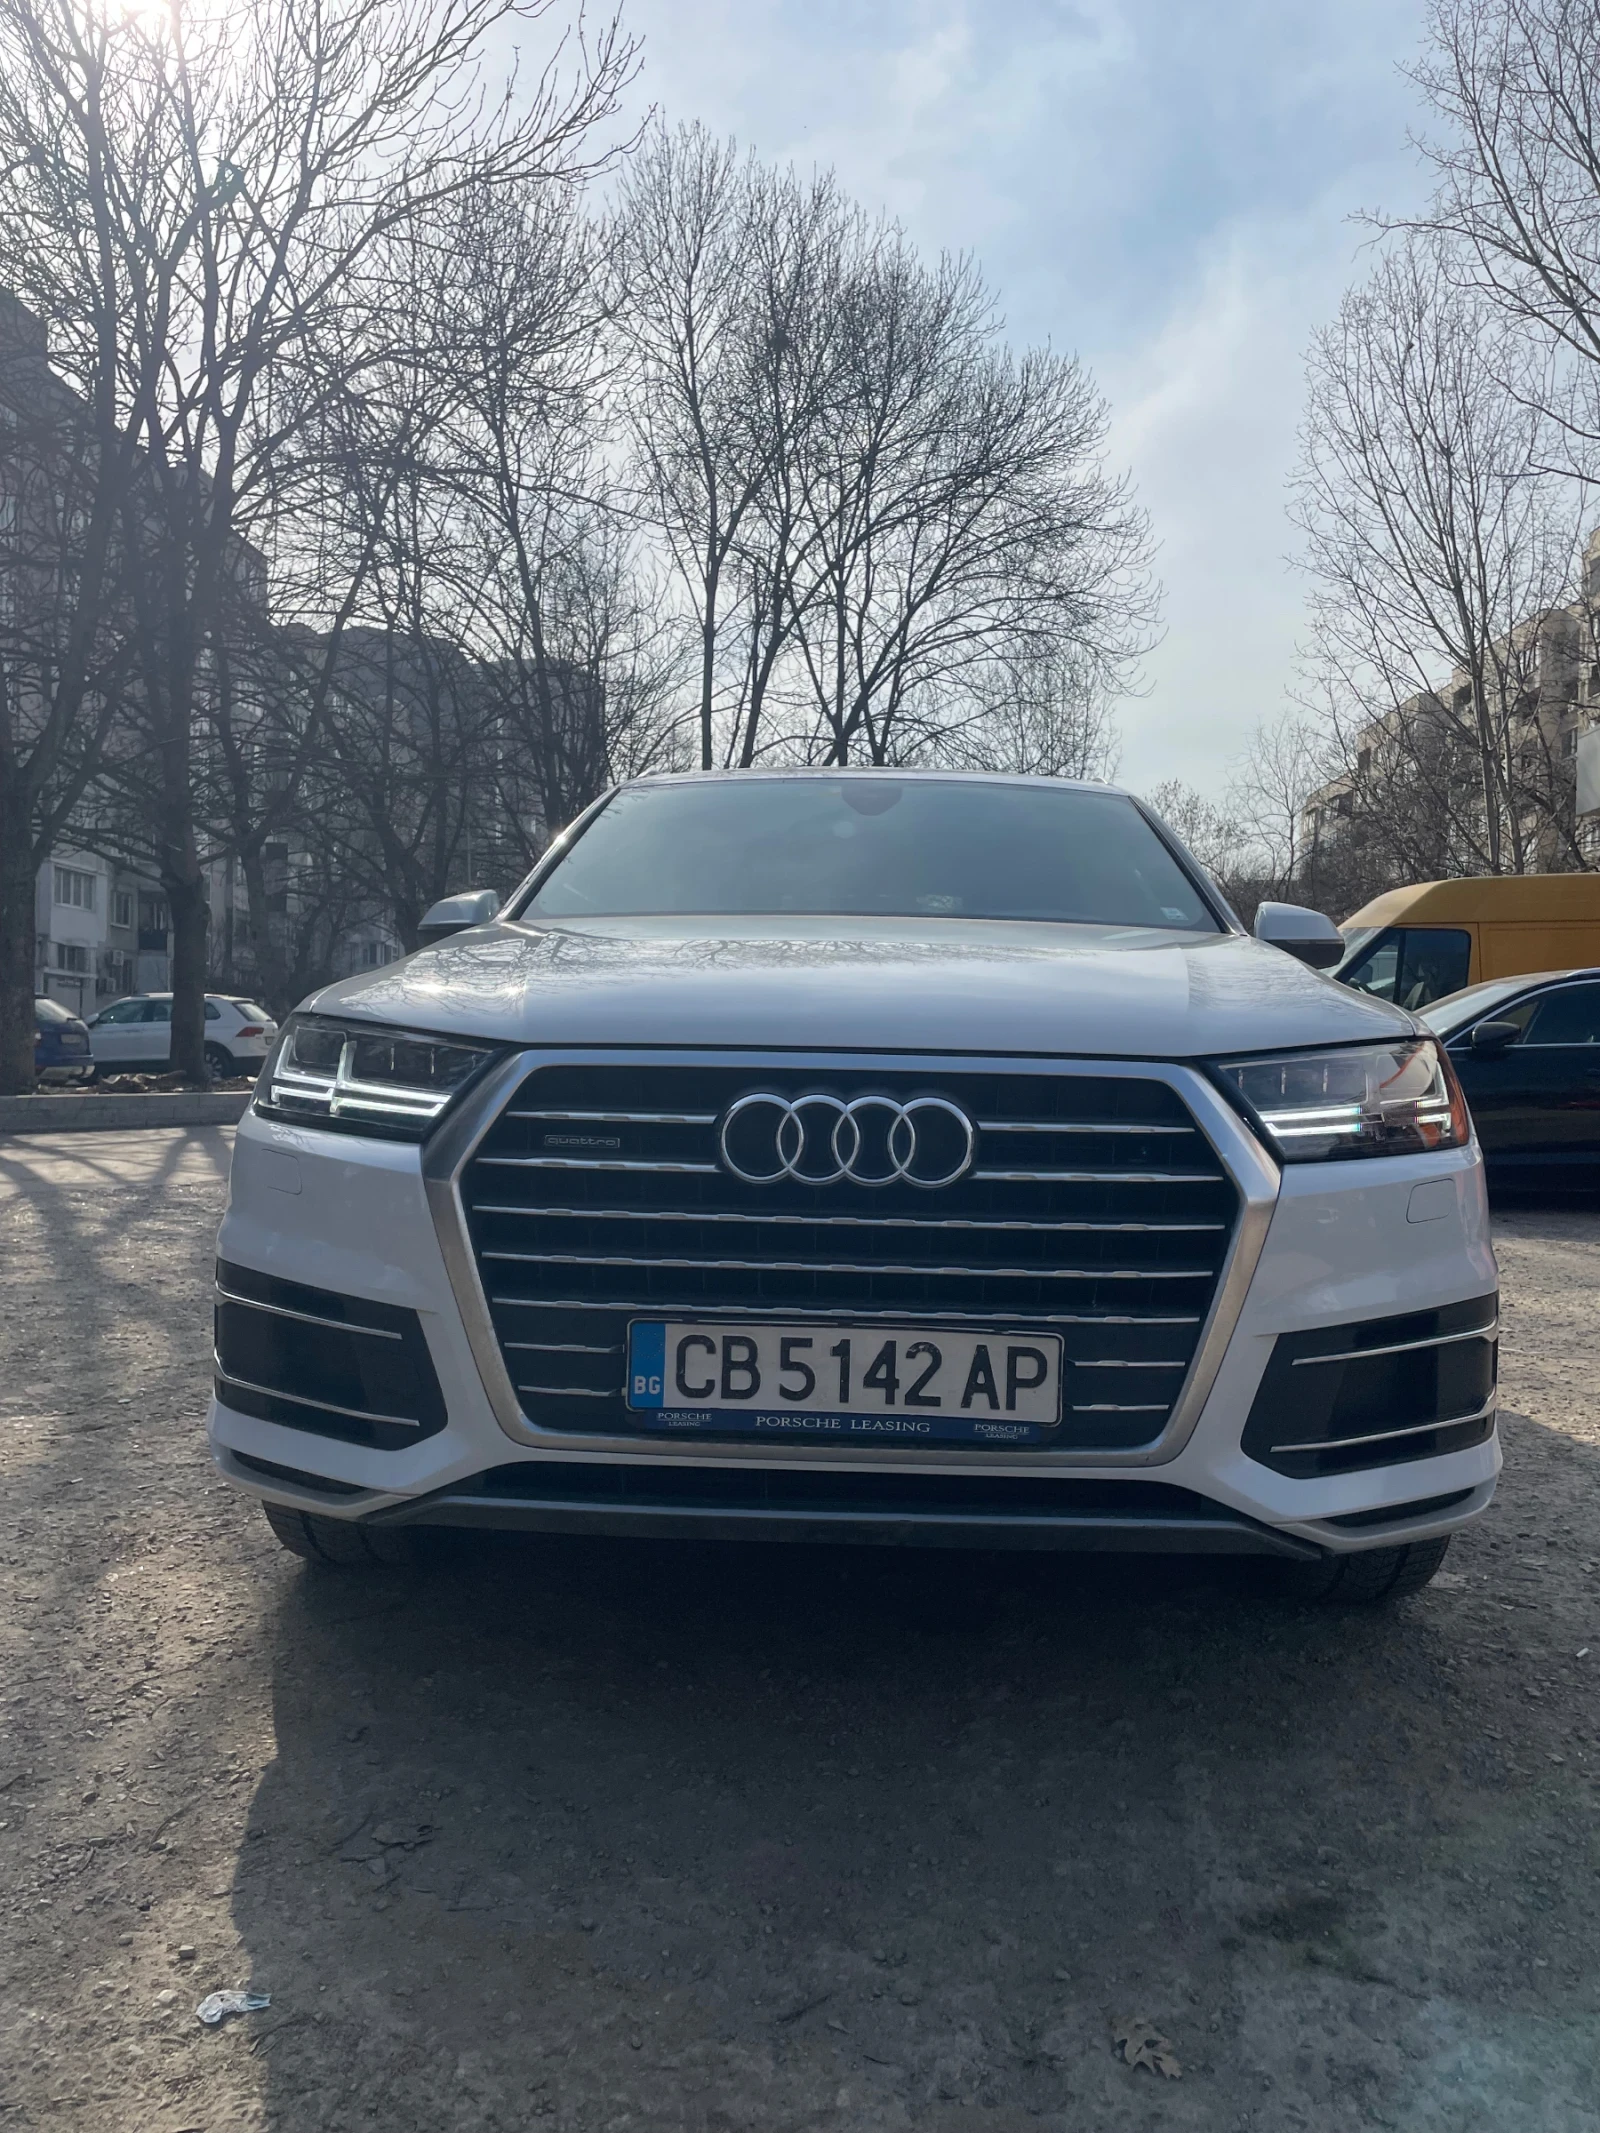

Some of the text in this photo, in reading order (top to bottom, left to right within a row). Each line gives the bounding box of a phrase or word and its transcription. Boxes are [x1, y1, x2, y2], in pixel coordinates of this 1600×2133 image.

[547, 1137, 616, 1146] quattro
[675, 1334, 1048, 1411] CB 5142 AP
[633, 1375, 661, 1395] BG
[657, 1412, 712, 1420] PORSCHE
[756, 1416, 930, 1433] PORSCHE LEASING
[974, 1423, 1030, 1434] PORSCHE
